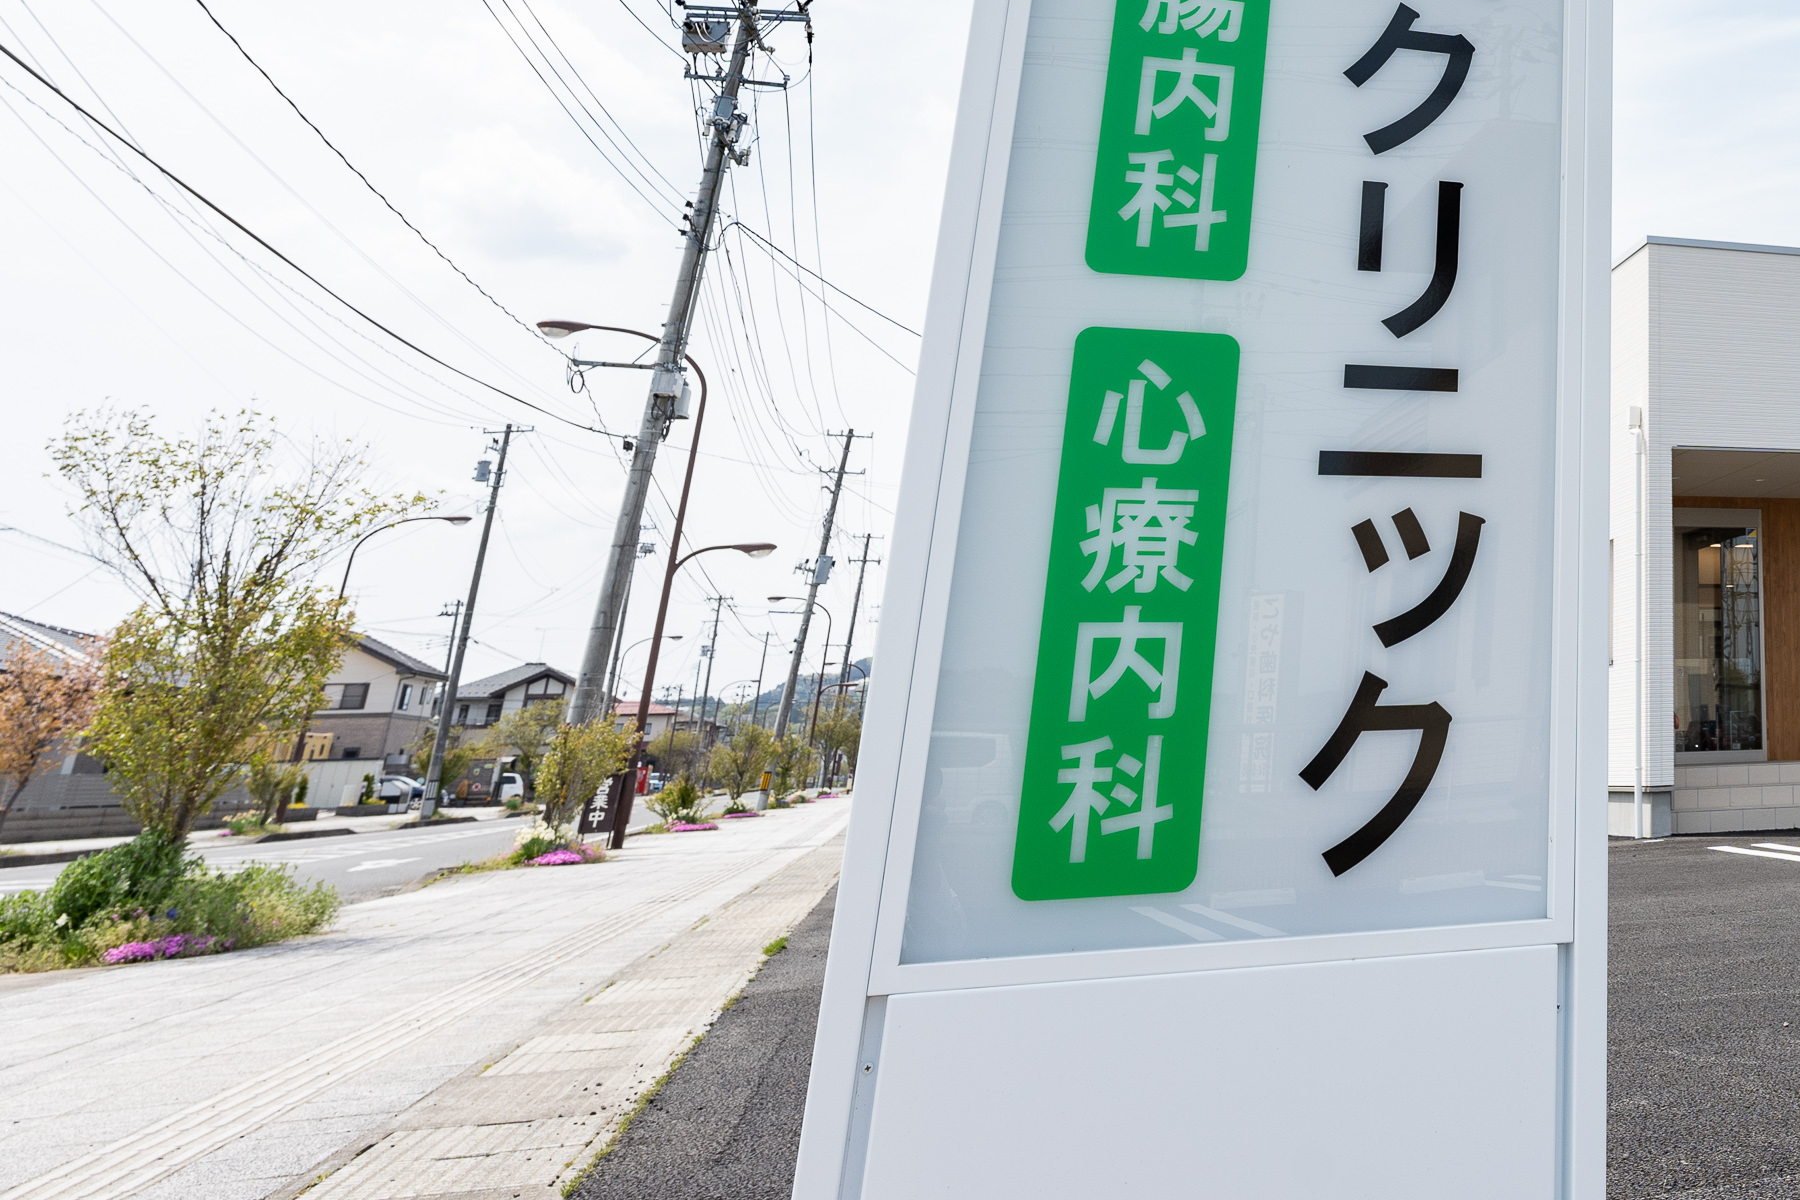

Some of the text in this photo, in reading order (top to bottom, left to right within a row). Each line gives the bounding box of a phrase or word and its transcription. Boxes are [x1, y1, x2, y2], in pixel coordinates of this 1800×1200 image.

[1049, 359, 1206, 863] 心療内科
[588, 776, 614, 828] 営業中
